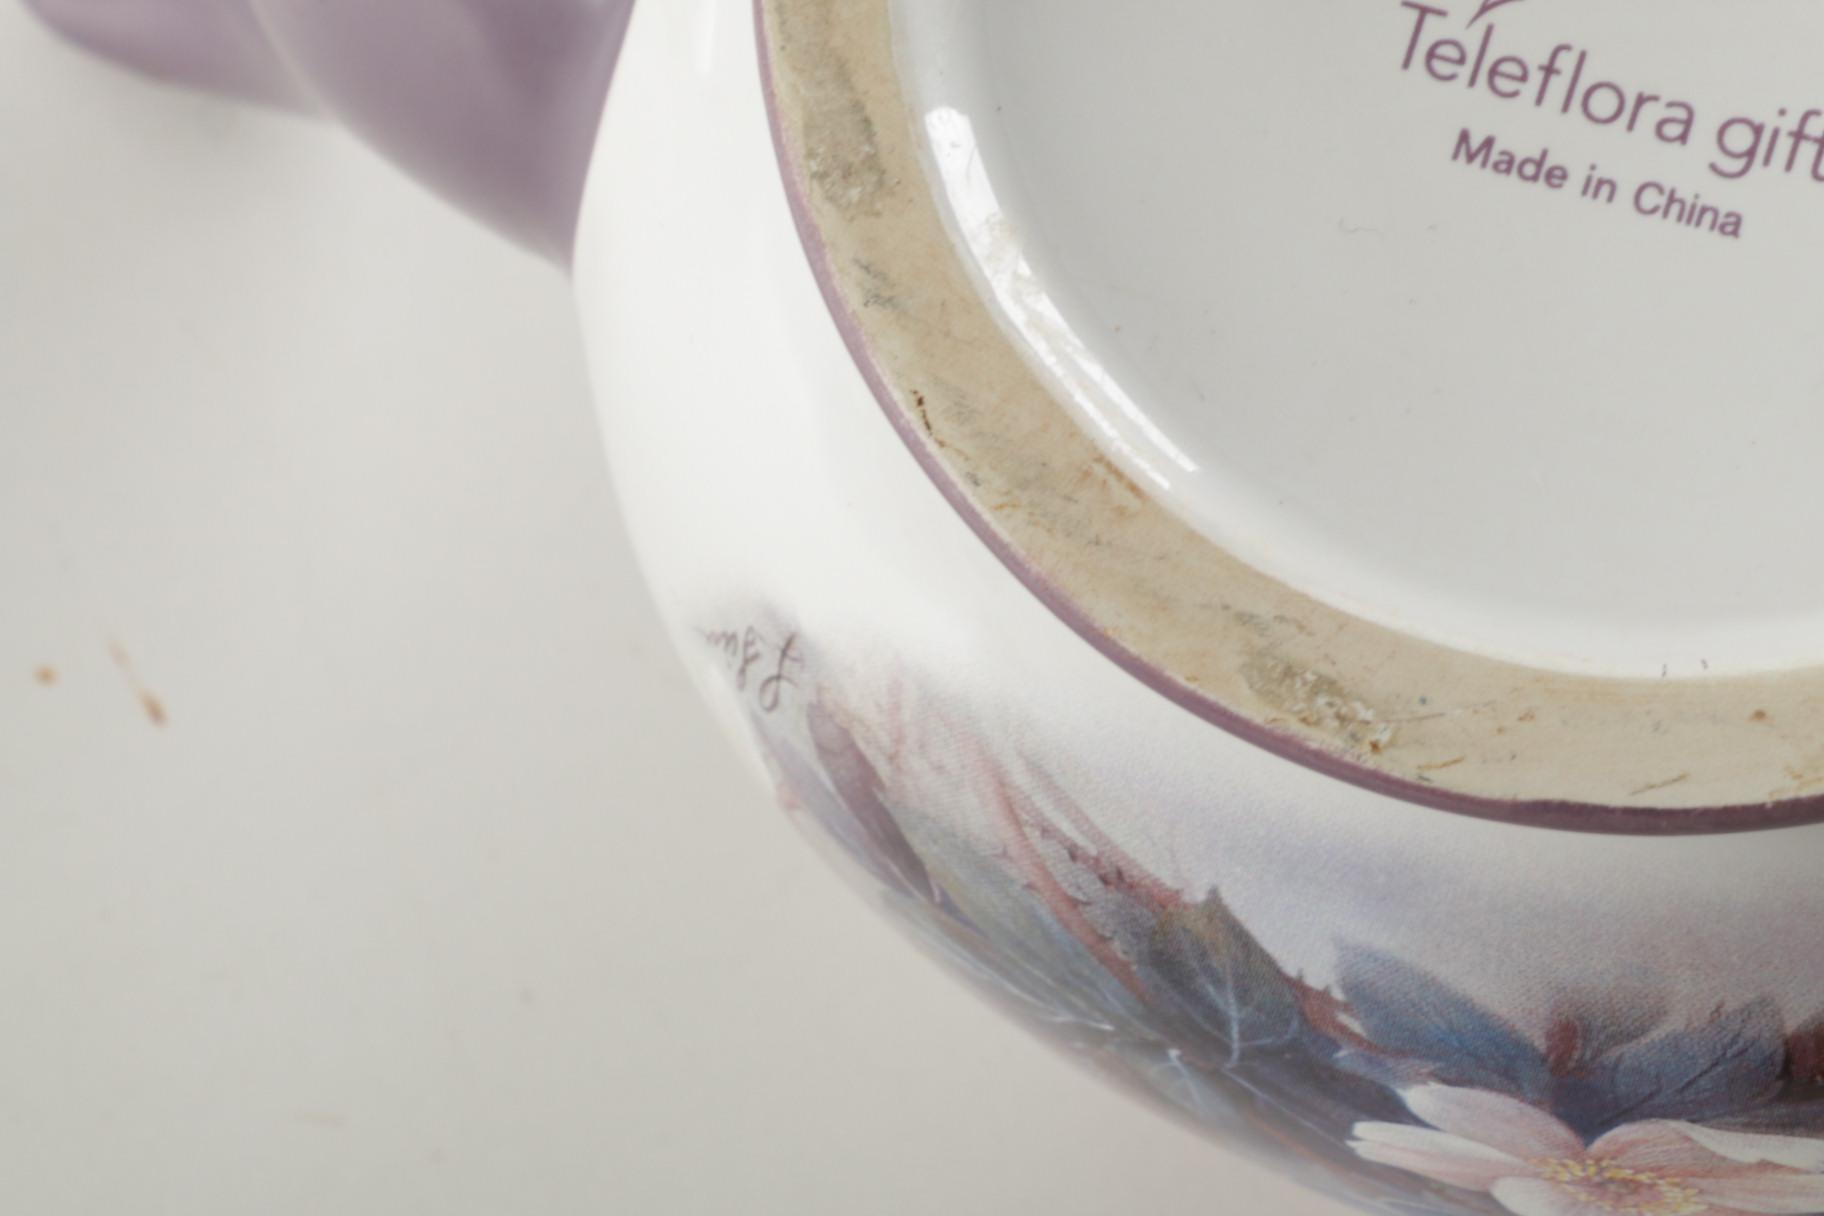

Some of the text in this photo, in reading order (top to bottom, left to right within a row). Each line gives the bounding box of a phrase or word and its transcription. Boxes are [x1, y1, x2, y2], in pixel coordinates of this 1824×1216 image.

[1400, 0, 1695, 146] Teleflora
[1451, 127, 1744, 239] Made in China
